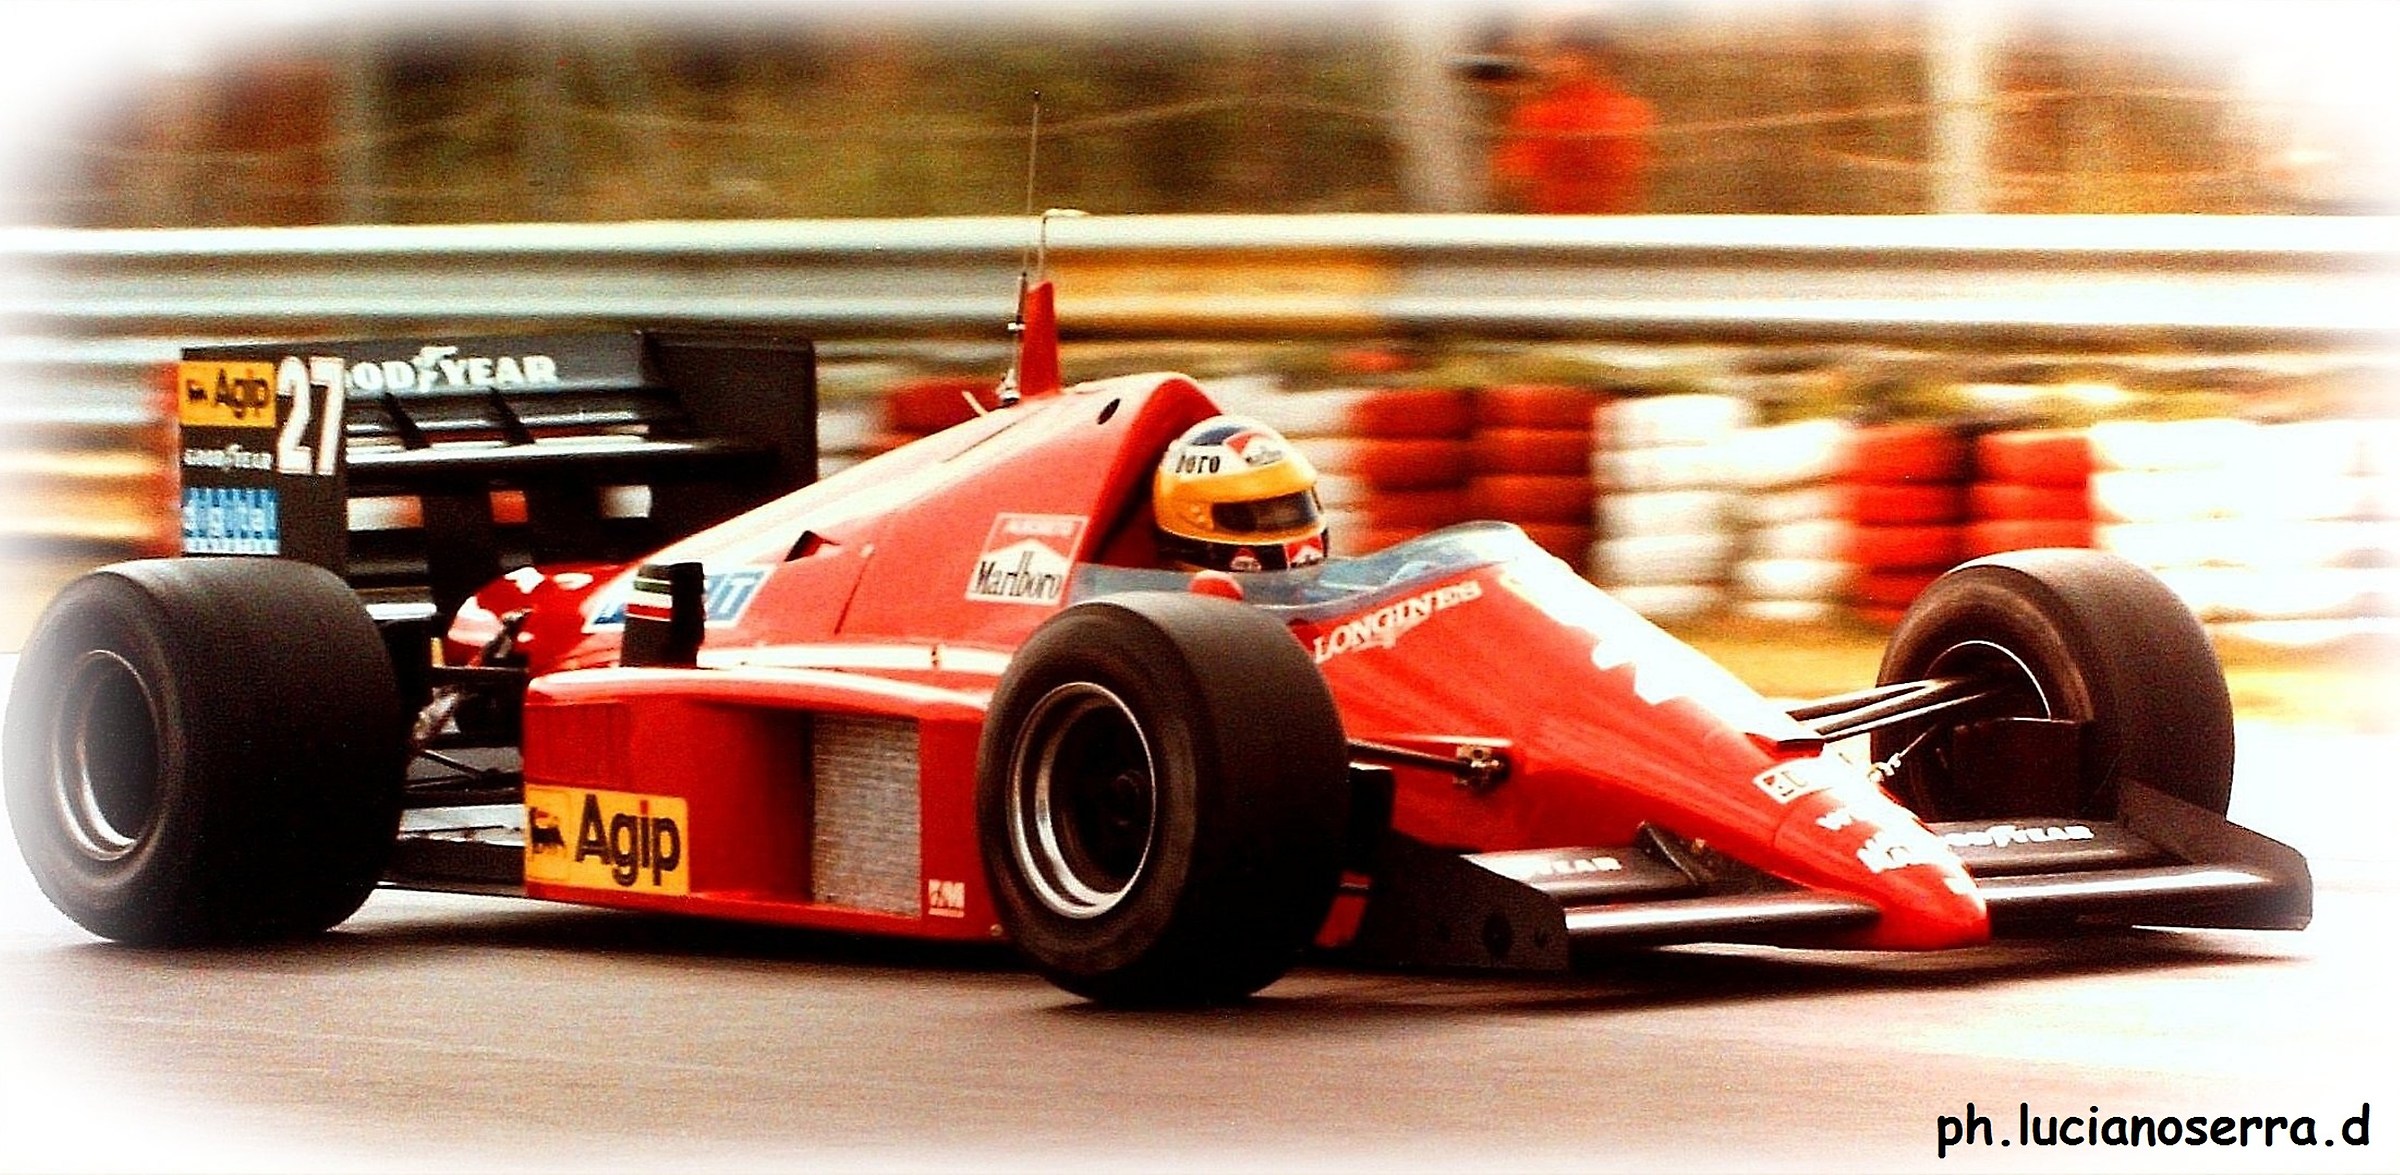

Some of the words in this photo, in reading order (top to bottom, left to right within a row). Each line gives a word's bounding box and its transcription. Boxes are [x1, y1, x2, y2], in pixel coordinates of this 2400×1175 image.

[214, 367, 270, 420] Agip
[277, 356, 345, 475] 27
[976, 551, 1062, 599] Marlboro
[1313, 580, 1482, 665] LONGINES
[575, 794, 681, 887] Agip
